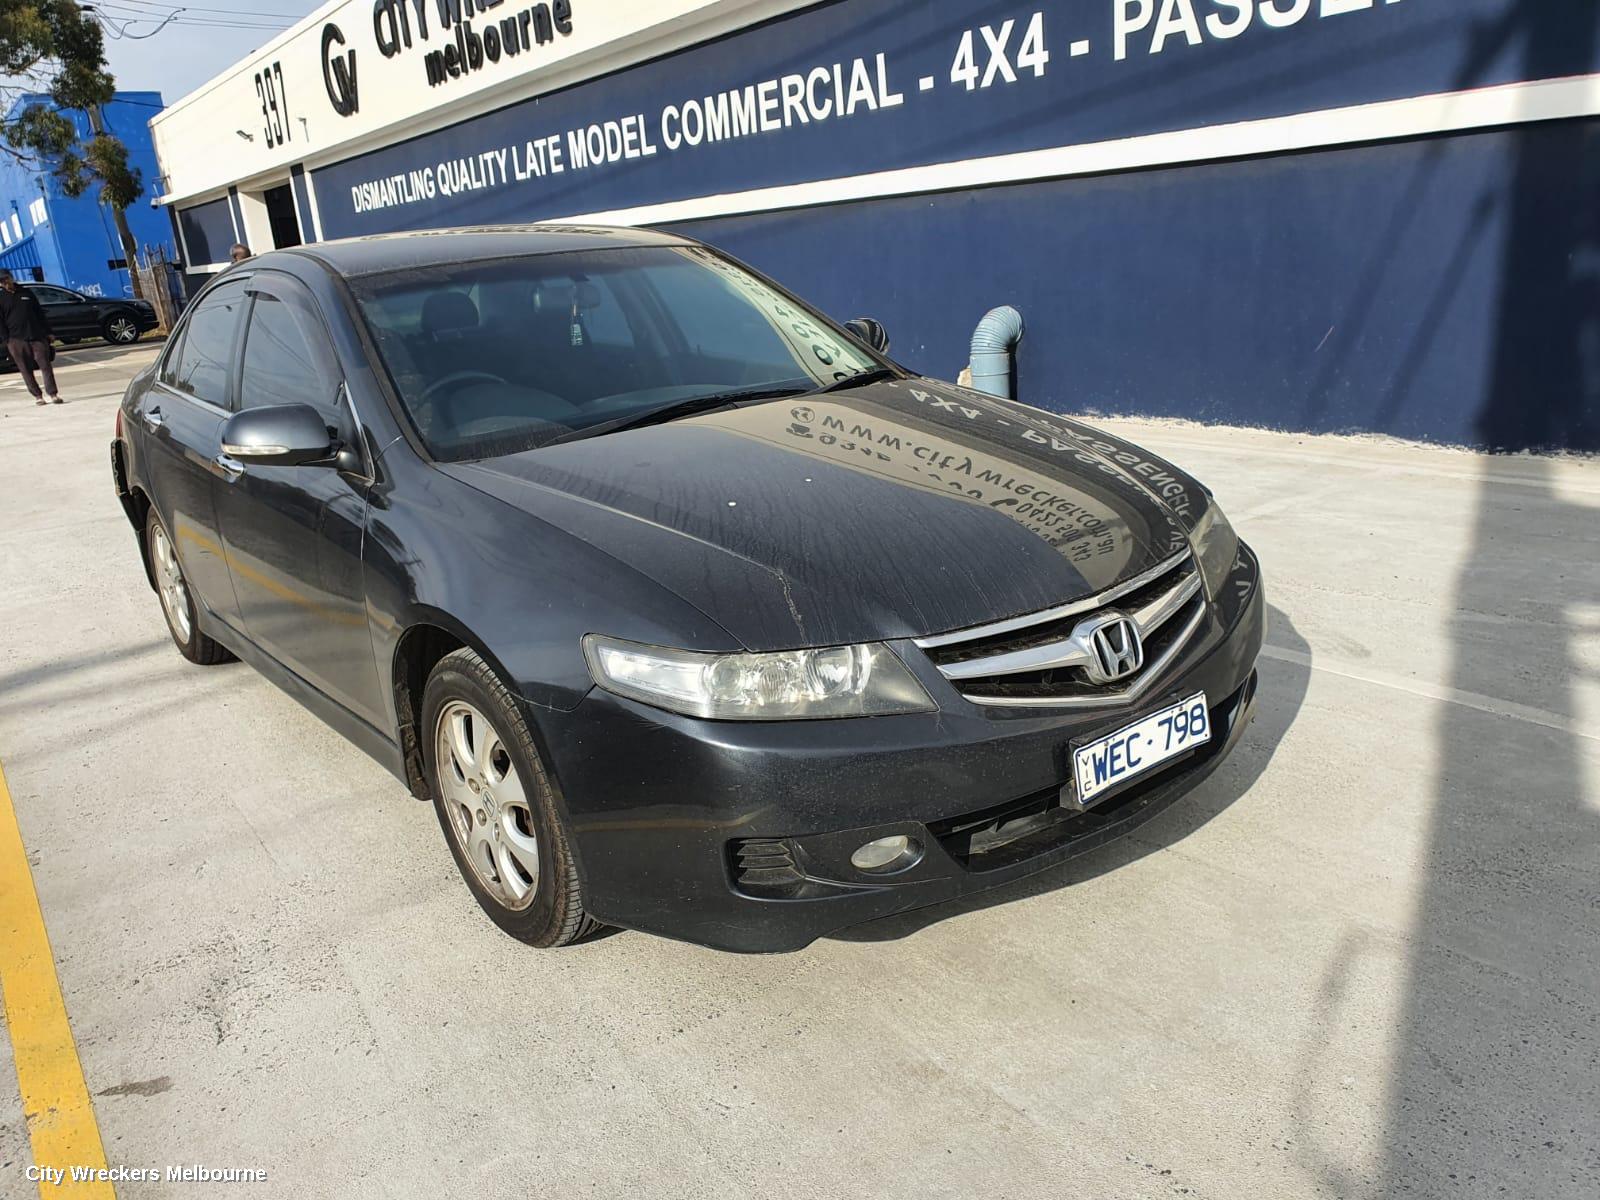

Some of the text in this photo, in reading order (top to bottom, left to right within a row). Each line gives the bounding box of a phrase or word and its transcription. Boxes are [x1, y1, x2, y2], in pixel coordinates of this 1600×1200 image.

[424, 0, 573, 87] melbourne
[254, 60, 291, 149] 397
[351, 166, 436, 213] DISMANTLING
[436, 147, 508, 197] QUALITY
[511, 134, 565, 181] LATE
[566, 113, 657, 170] MODEL
[660, 52, 904, 151] COMMERCIAL
[949, 11, 1049, 91] 4X4
